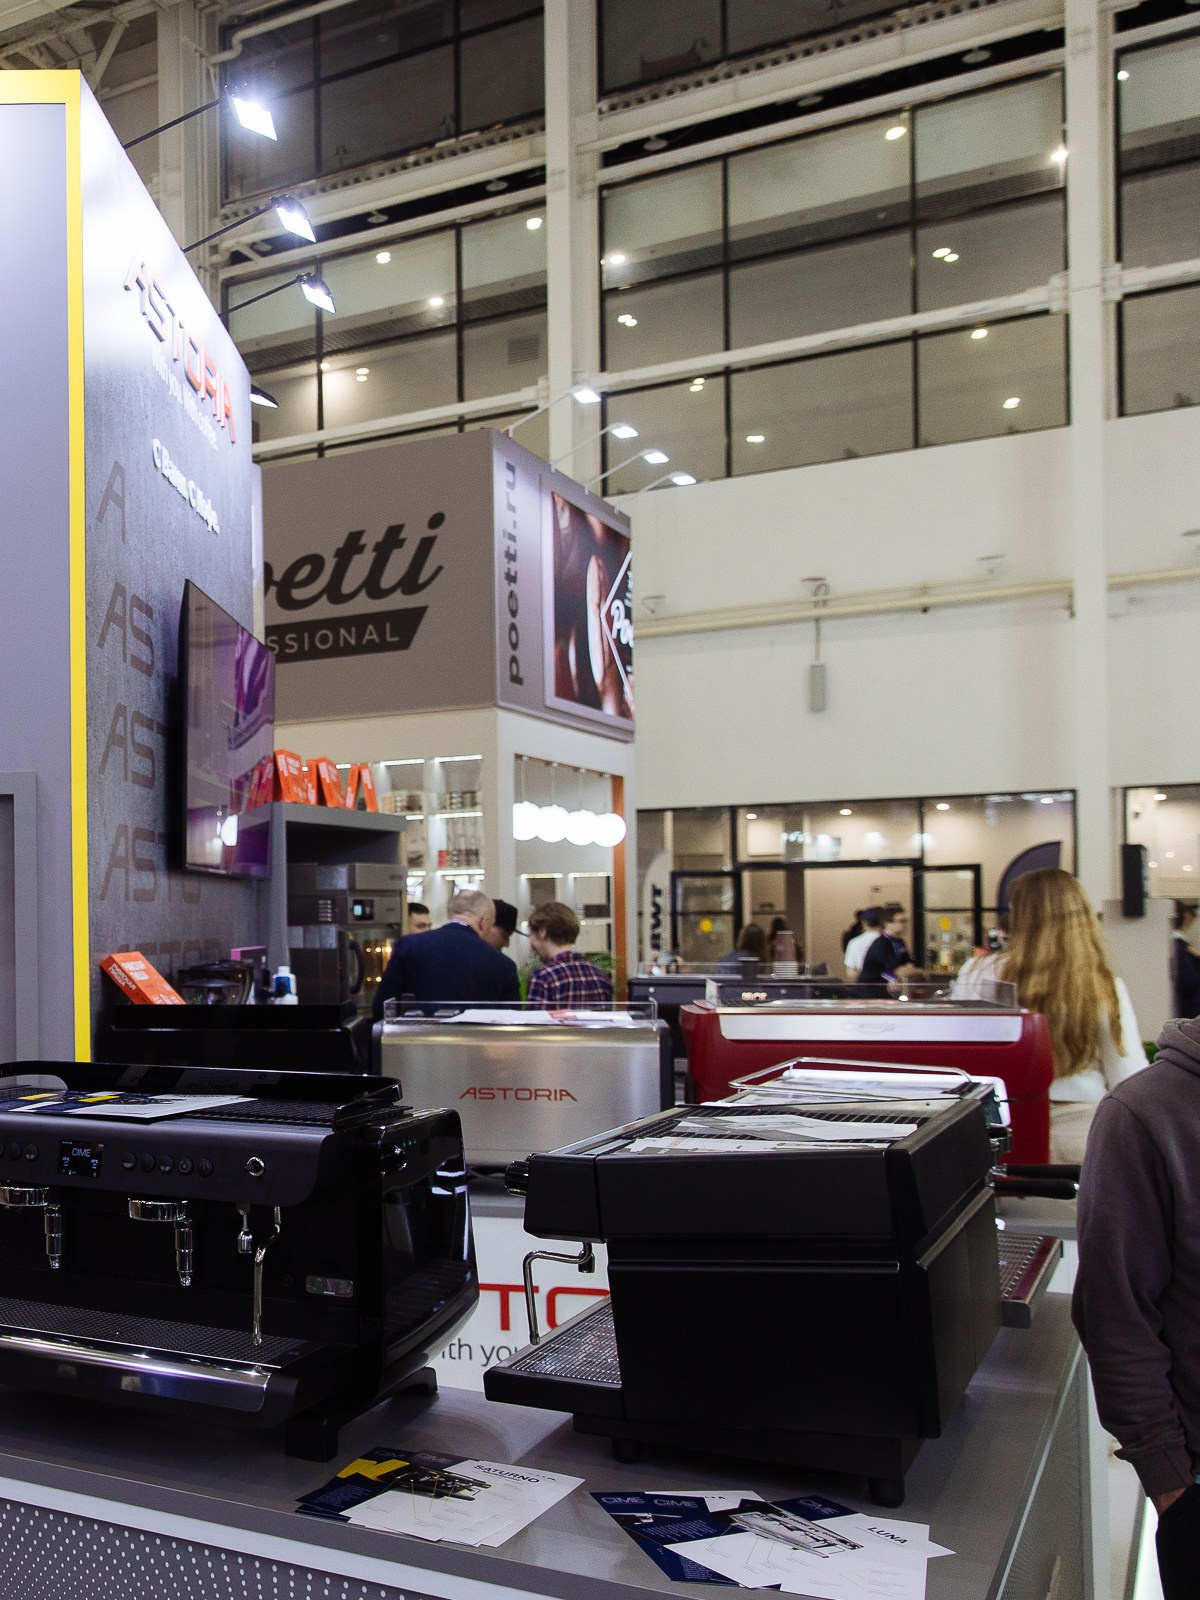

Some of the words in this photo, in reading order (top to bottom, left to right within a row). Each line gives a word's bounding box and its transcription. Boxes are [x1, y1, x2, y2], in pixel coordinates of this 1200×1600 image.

[502, 461, 524, 686] poetti.ru
[266, 622, 400, 657] SSIONAL
[459, 1087, 578, 1102] ASTORIA
[71, 1147, 91, 1158] CIME
[474, 1464, 540, 1484] SATURNO
[653, 1498, 699, 1509] CIME
[867, 1526, 908, 1544] LUNA
